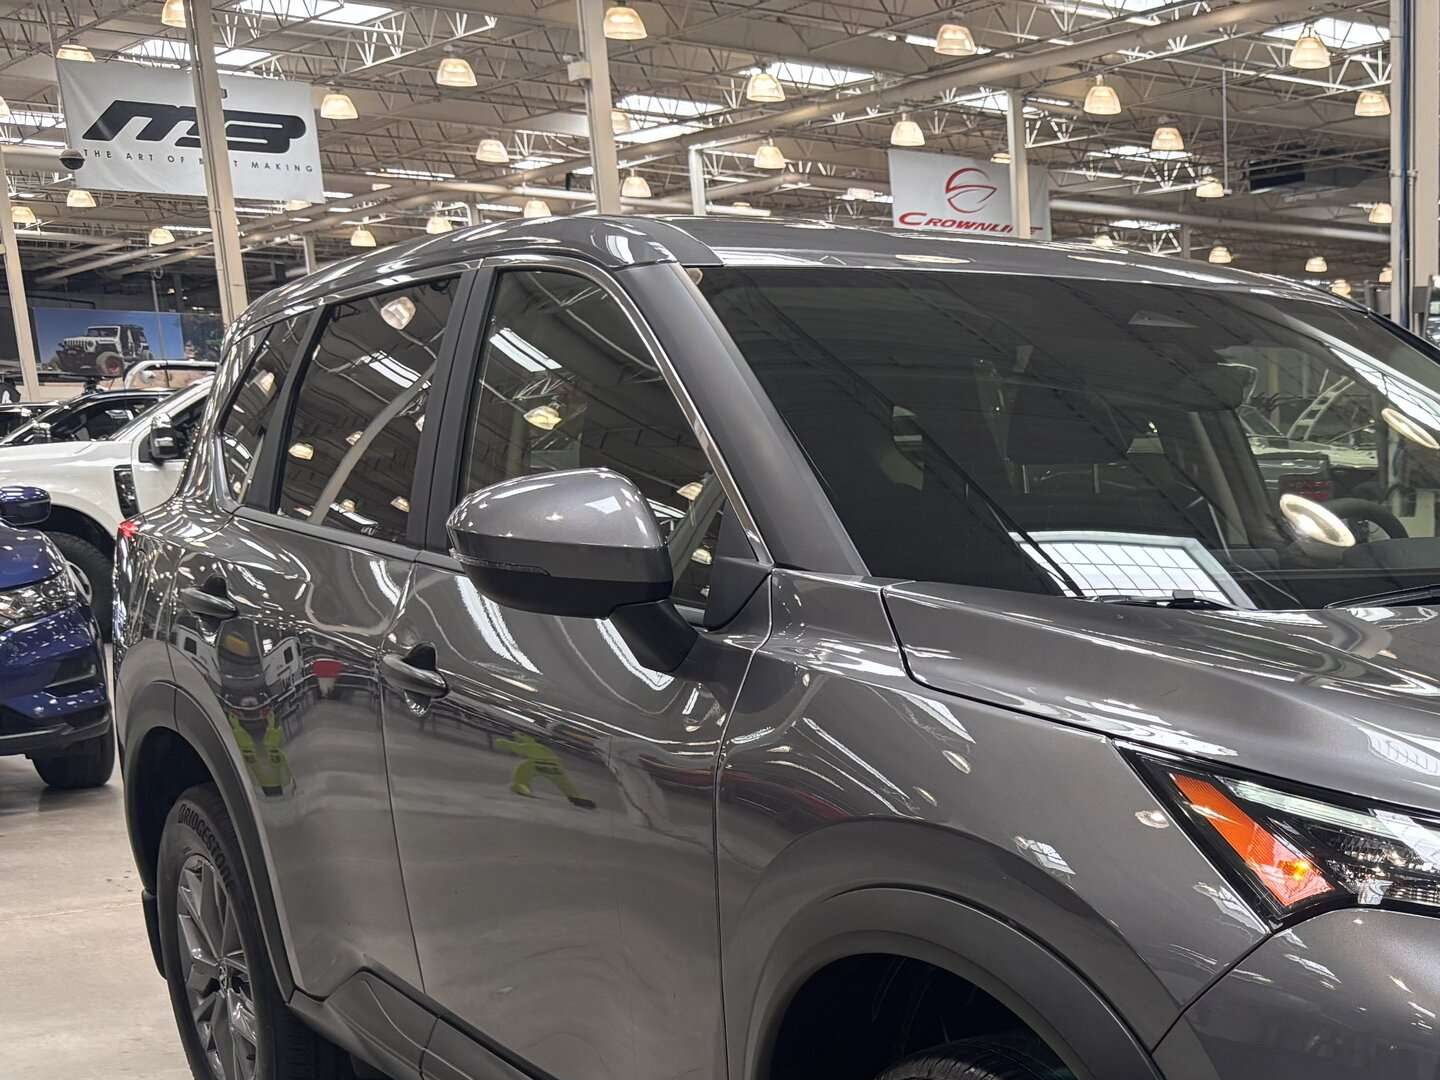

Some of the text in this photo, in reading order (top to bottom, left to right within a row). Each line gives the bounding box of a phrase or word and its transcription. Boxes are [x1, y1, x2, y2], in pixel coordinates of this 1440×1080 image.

[83, 149, 314, 172] THE ART OF MAKING
